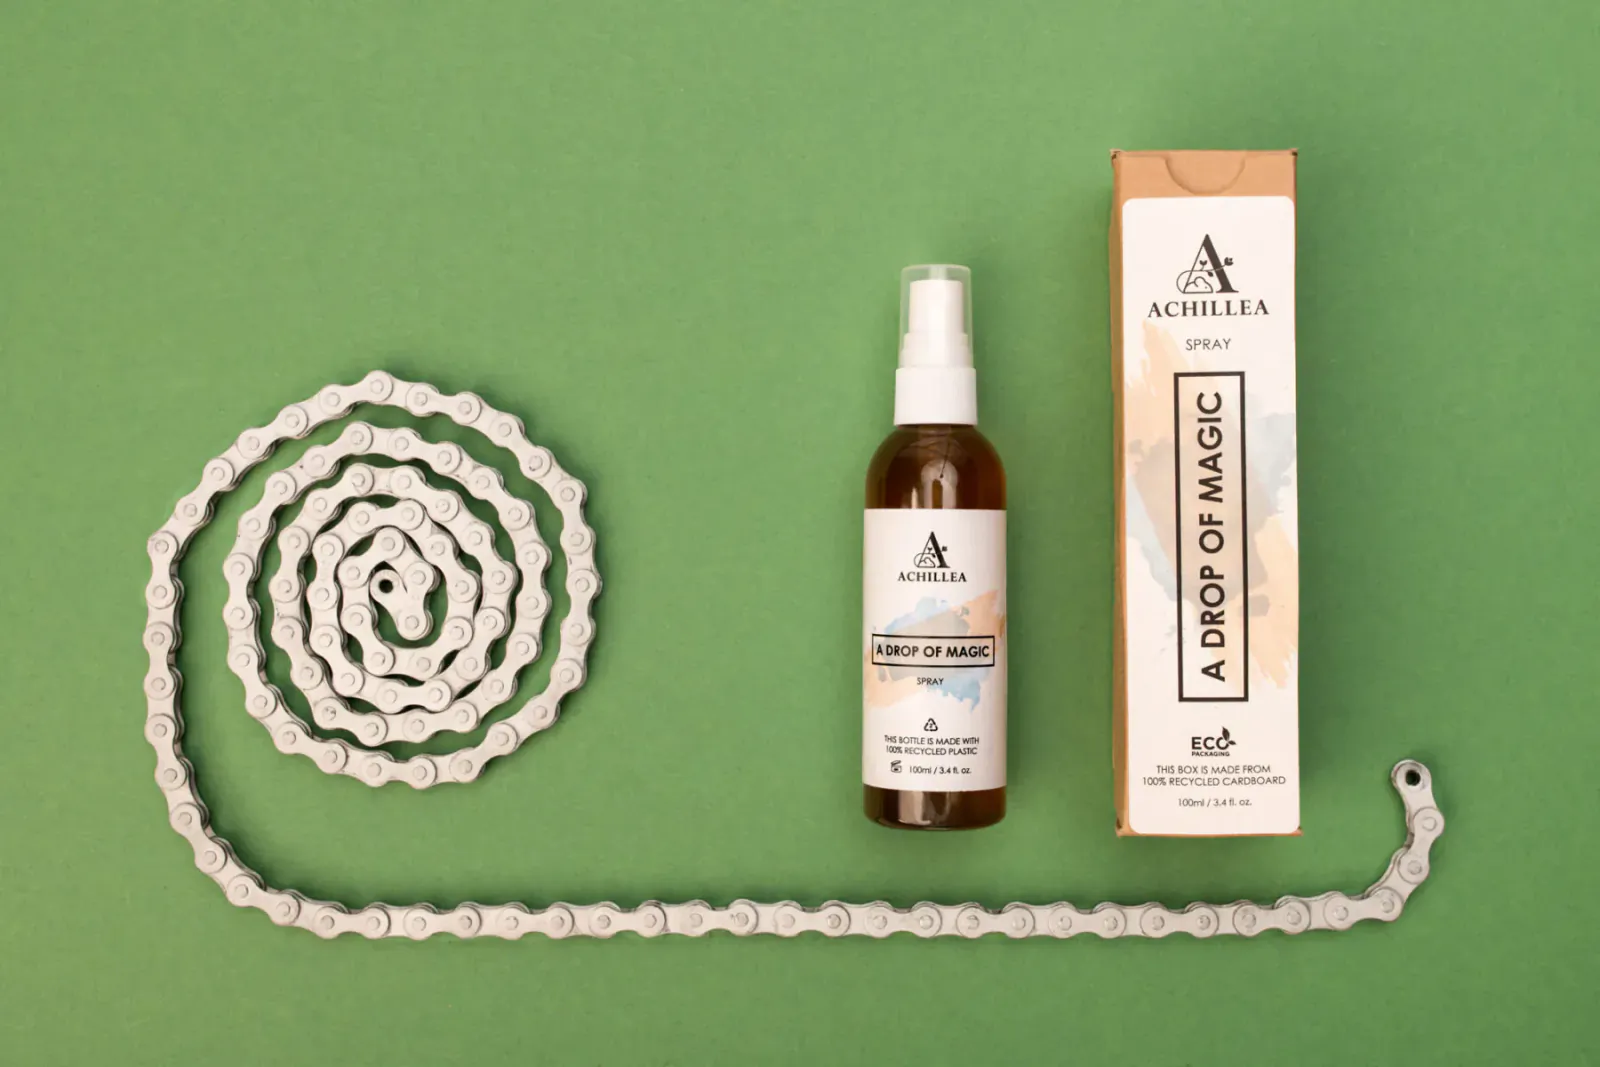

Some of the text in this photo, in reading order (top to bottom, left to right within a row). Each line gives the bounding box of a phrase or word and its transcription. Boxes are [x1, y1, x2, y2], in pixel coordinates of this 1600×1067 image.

[1147, 299, 1269, 318] ACHILLEA
[1185, 338, 1231, 351] SPRAY
[1196, 391, 1226, 682] A DROP OF MAGIC
[897, 571, 967, 582] ACHILLEA
[876, 644, 990, 658] A DROP OF MAGIC
[916, 677, 944, 686] SPRAY
[884, 734, 980, 745] THIS BOTTLE IS MADE WITH
[1191, 736, 1230, 750] ECO
[886, 745, 978, 755] 100% RECYCLED PLASTIC
[909, 766, 932, 774] 100ml
[933, 766, 938, 775] /
[1156, 765, 1271, 774] THIS BOX IS MADE FROM
[1142, 776, 1286, 786] 100% RECYCLED CARDBOARD
[1178, 798, 1252, 808] 100ml / 3.4 fl. oz.
